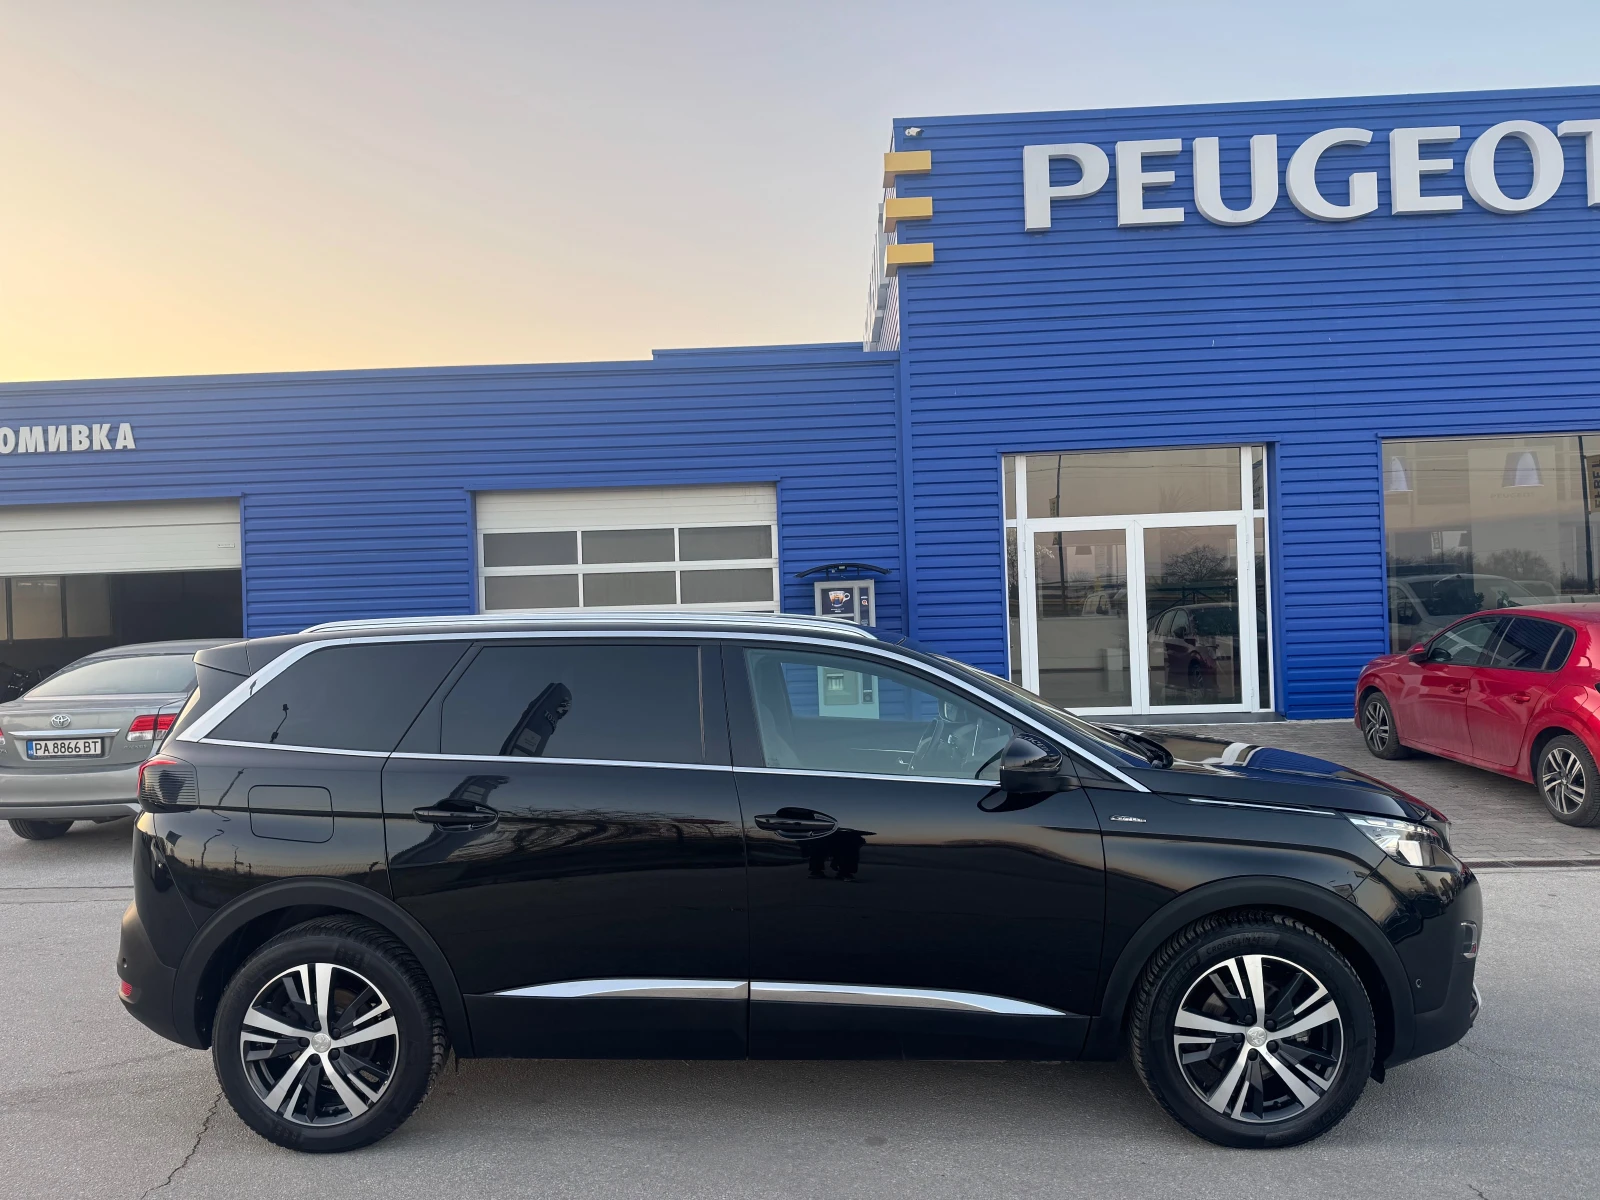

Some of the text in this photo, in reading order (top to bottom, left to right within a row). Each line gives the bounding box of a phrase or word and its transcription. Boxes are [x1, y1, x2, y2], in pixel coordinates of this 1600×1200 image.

[0, 422, 136, 454] ОМИВКА
[34, 742, 50, 755] PA
[52, 741, 81, 754] 8866
[83, 740, 99, 753] BT
